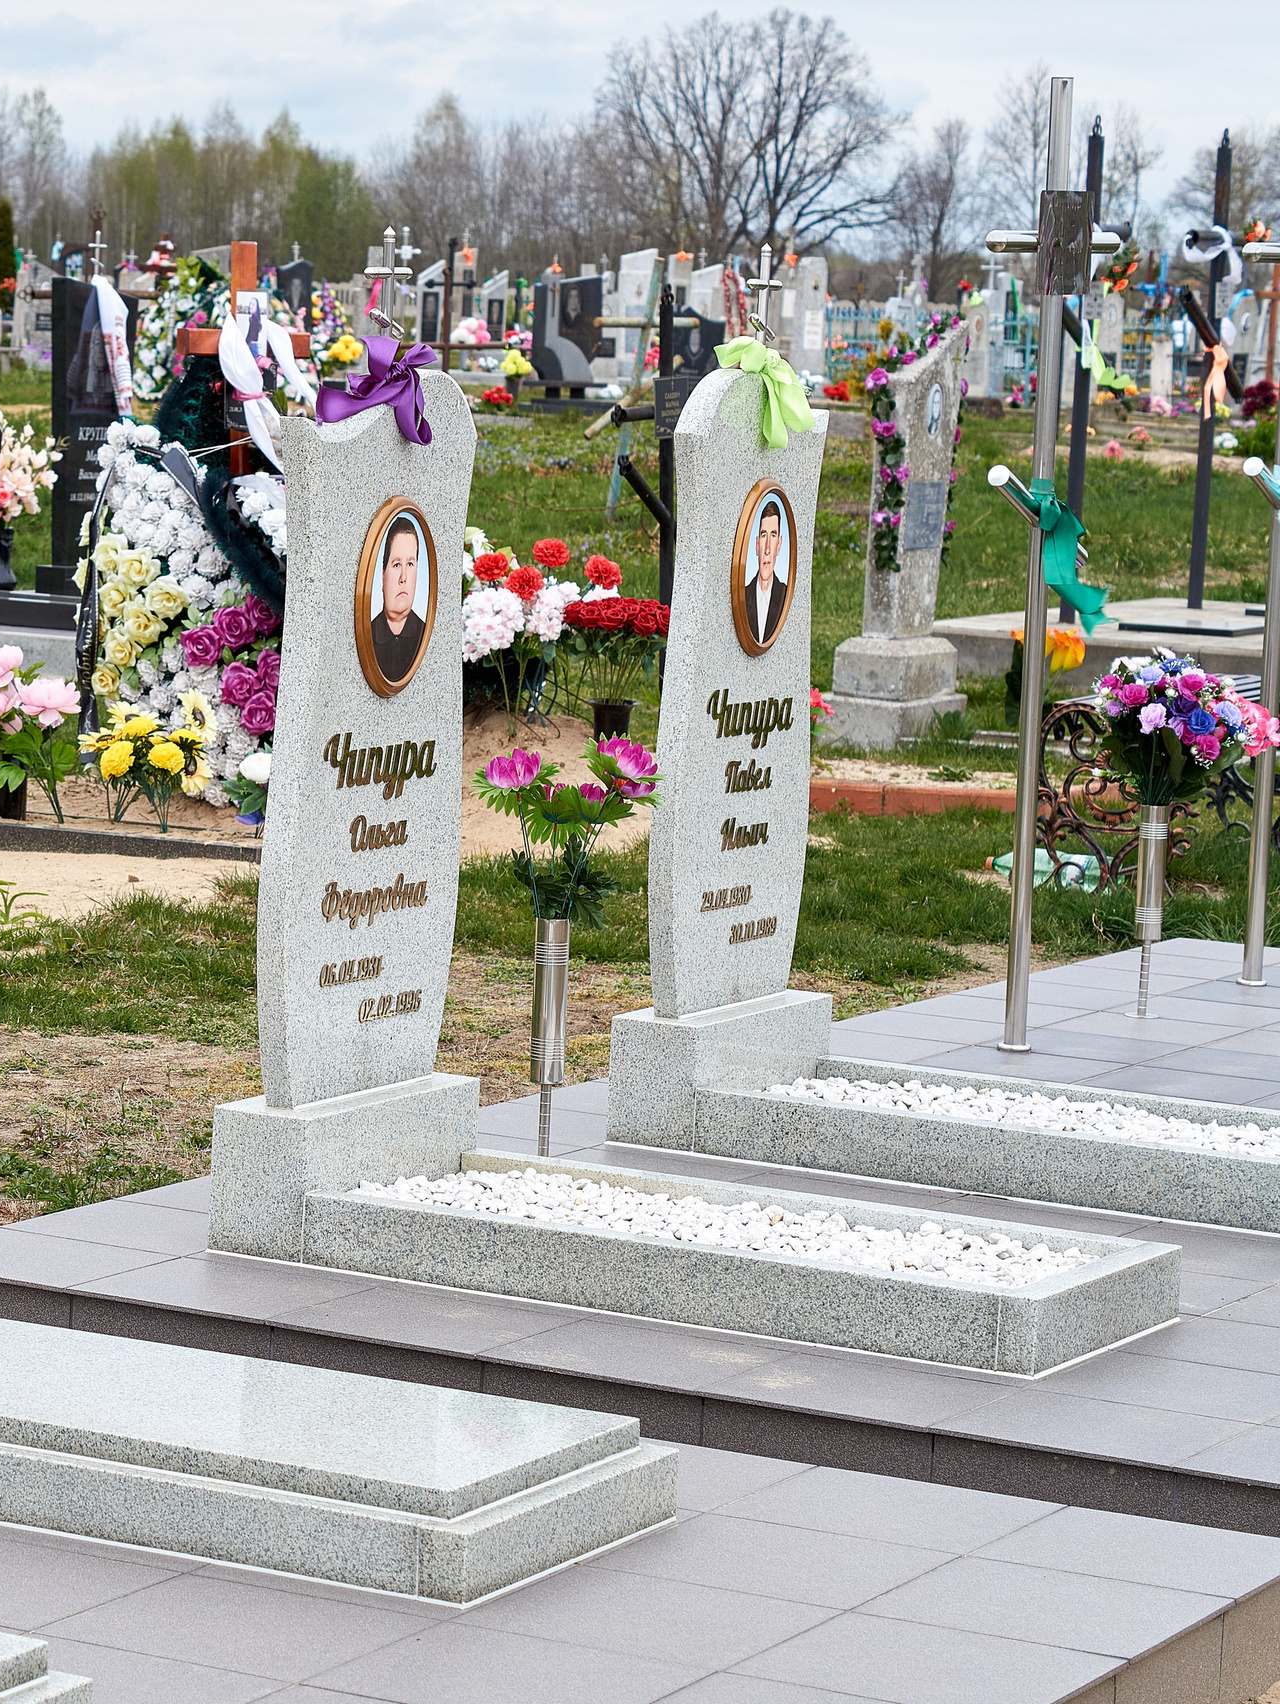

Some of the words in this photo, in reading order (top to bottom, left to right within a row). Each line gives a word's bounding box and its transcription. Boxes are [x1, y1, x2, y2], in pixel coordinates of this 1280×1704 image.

[78, 427, 108, 441] КРУП
[706, 688, 794, 750] Чипура
[323, 731, 437, 801] Чипура
[724, 758, 772, 794] Павел
[349, 814, 409, 853] Ольга
[720, 817, 769, 851] Ильич
